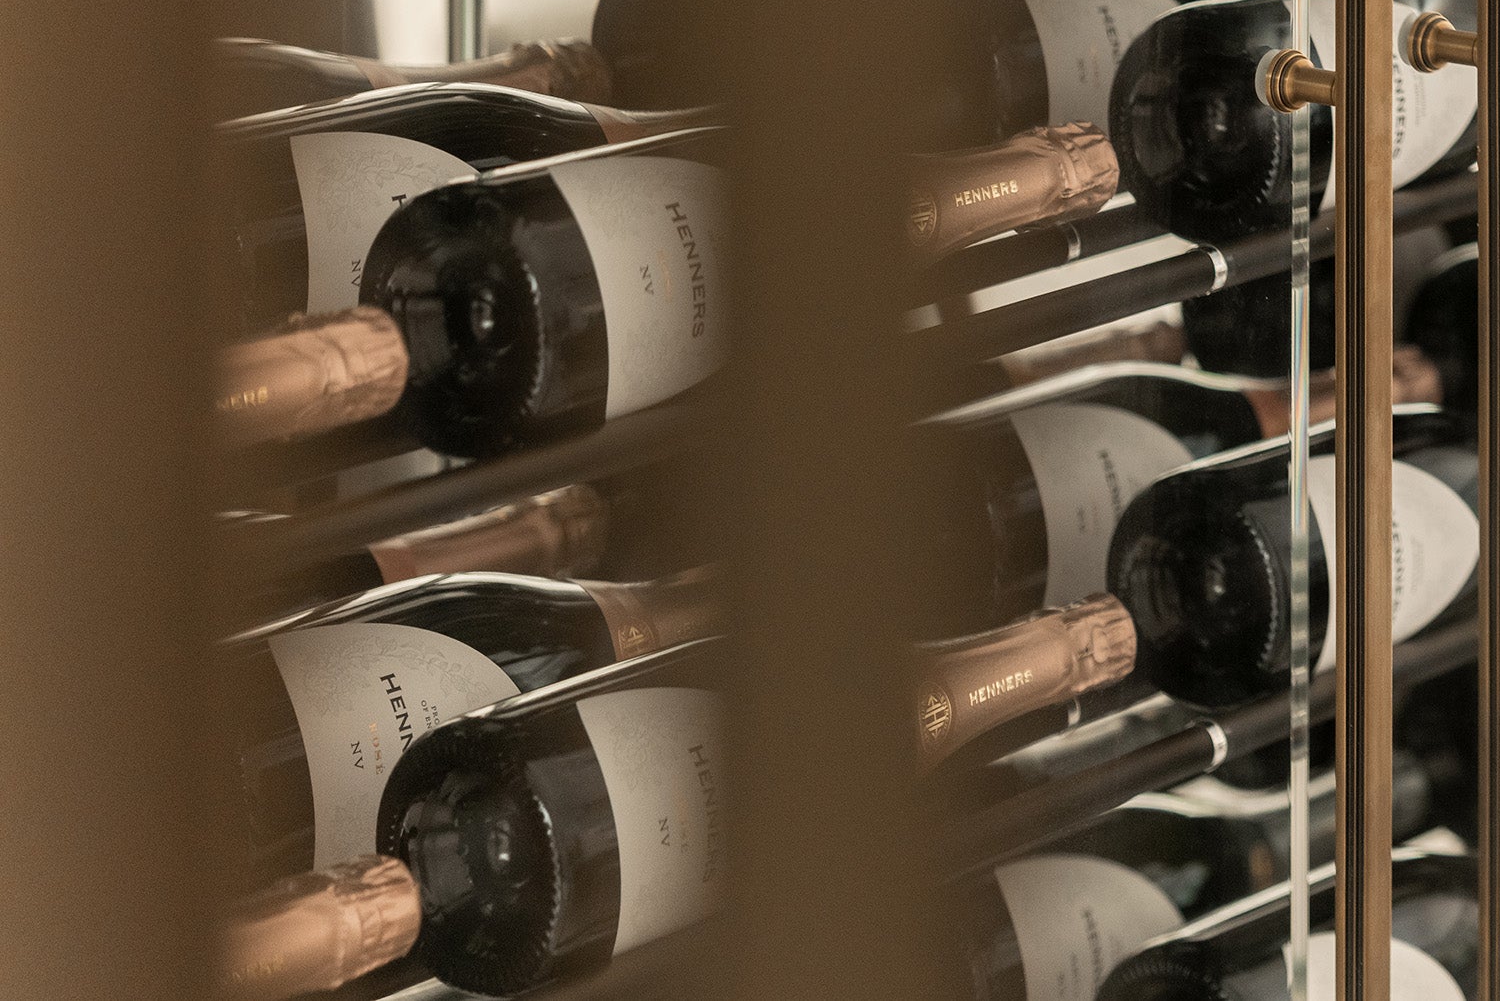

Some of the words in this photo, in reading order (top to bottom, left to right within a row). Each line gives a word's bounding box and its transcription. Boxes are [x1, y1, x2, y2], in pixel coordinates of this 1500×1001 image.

[954, 179, 1019, 207] HENNERS
[639, 263, 655, 295] NV
[665, 202, 706, 338] HENNERS
[969, 669, 1034, 707] HENNERS
[350, 741, 365, 770] NV
[658, 817, 671, 847] NV
